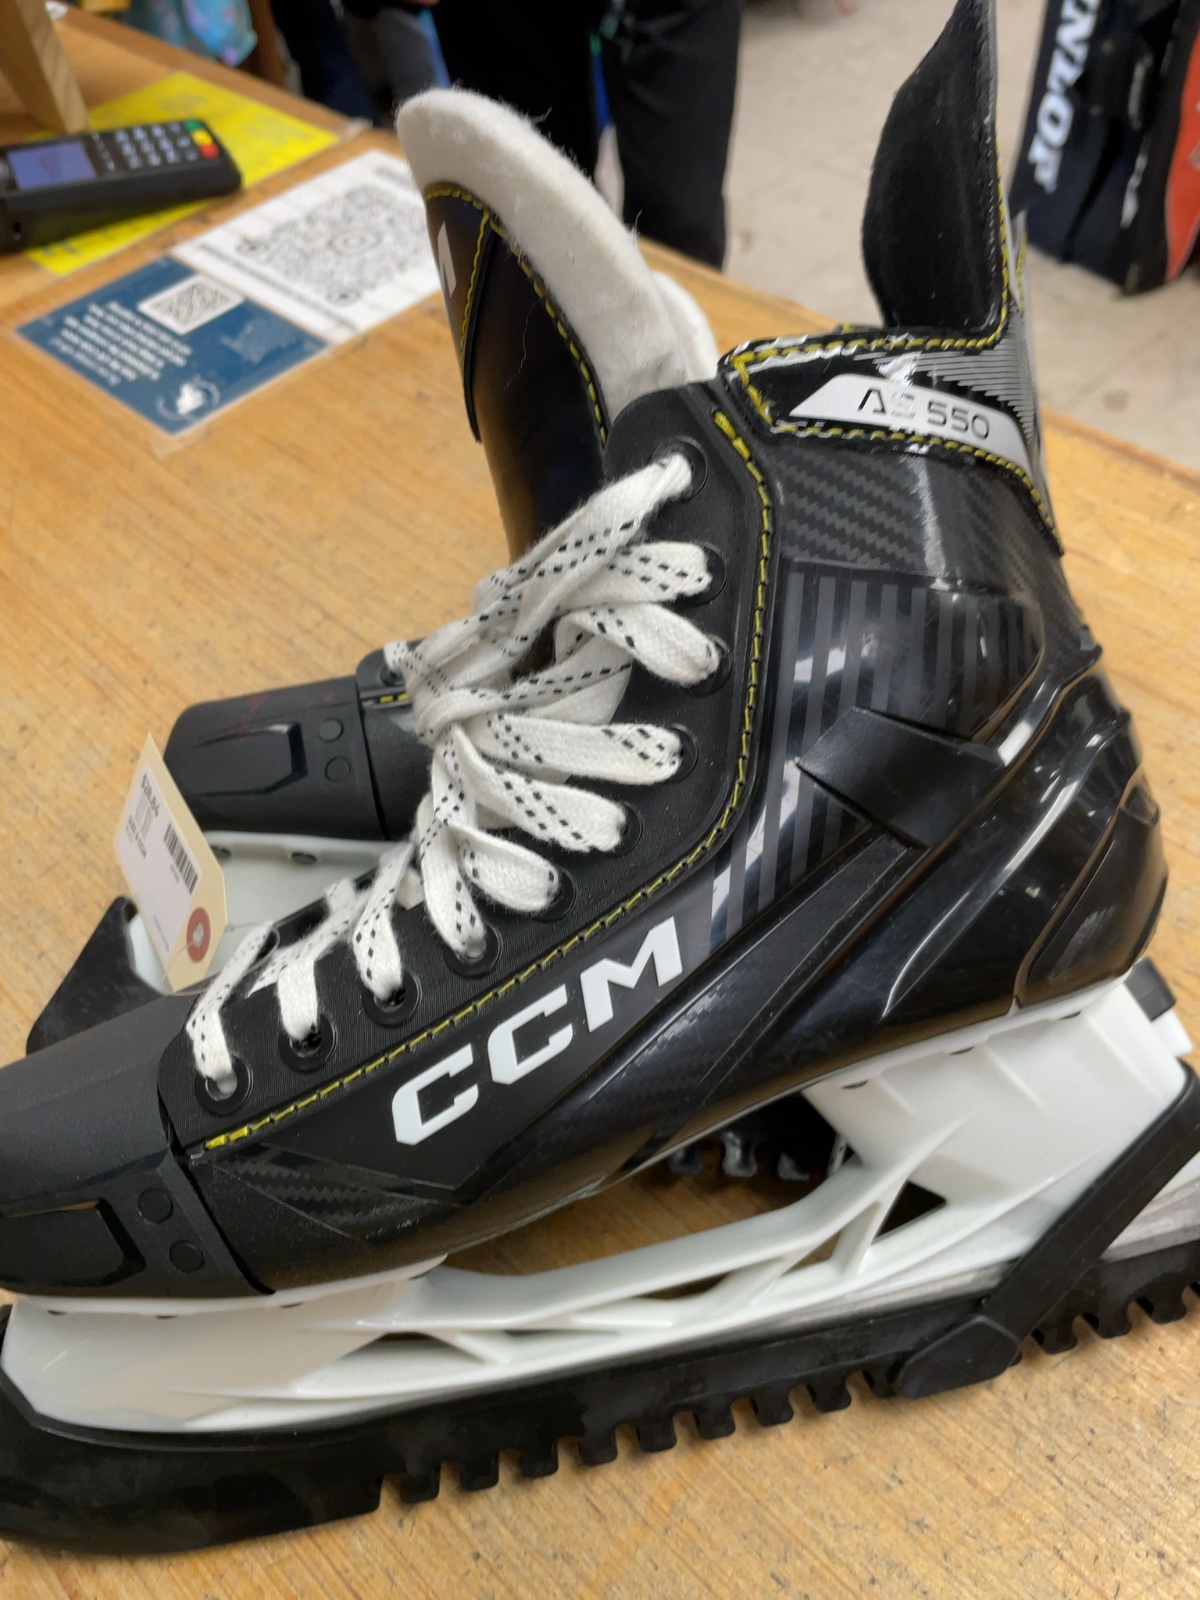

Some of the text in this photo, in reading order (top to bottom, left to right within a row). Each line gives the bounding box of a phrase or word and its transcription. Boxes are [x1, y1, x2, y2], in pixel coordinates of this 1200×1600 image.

[857, 387, 990, 440] AS 550
[391, 915, 683, 1146] CCM
